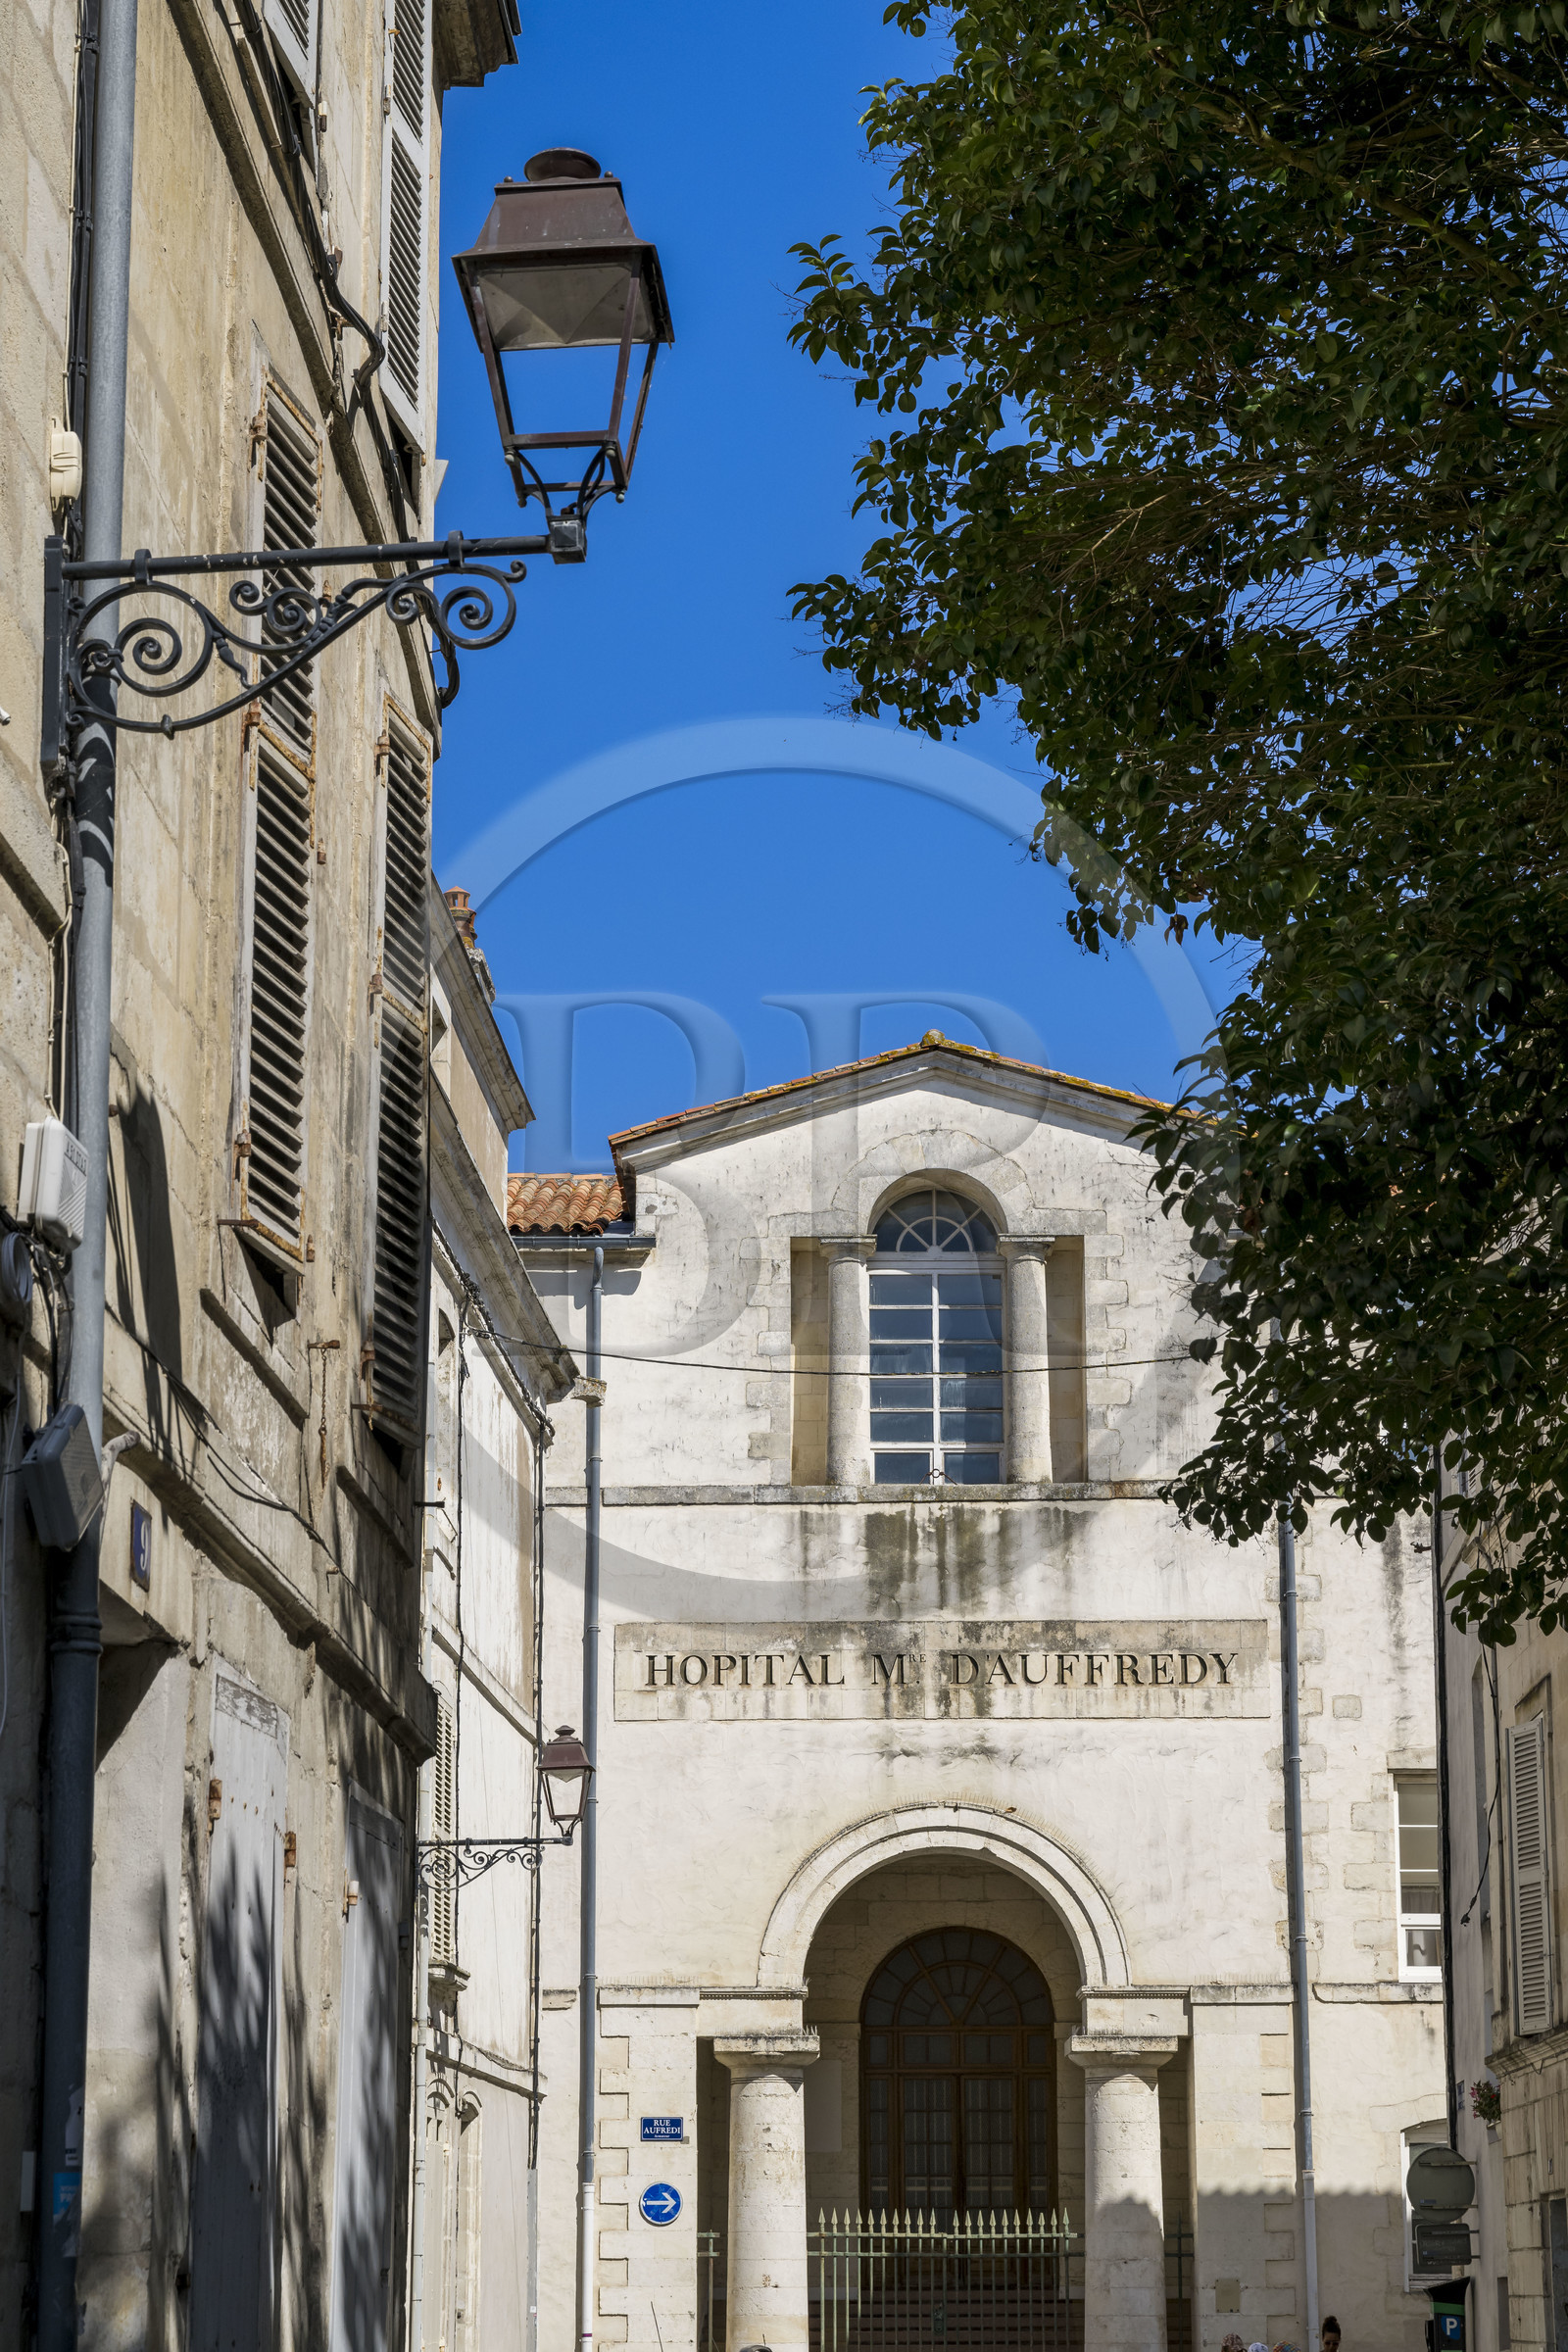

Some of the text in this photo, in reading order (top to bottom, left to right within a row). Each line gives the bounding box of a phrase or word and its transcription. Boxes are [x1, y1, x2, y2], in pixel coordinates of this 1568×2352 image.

[140, 1521, 149, 1571] 9
[645, 1653, 845, 1686] HOPITAL
[950, 1652, 1239, 1686] D'AUFFREDY
[1446, 2318, 1458, 2336] P
